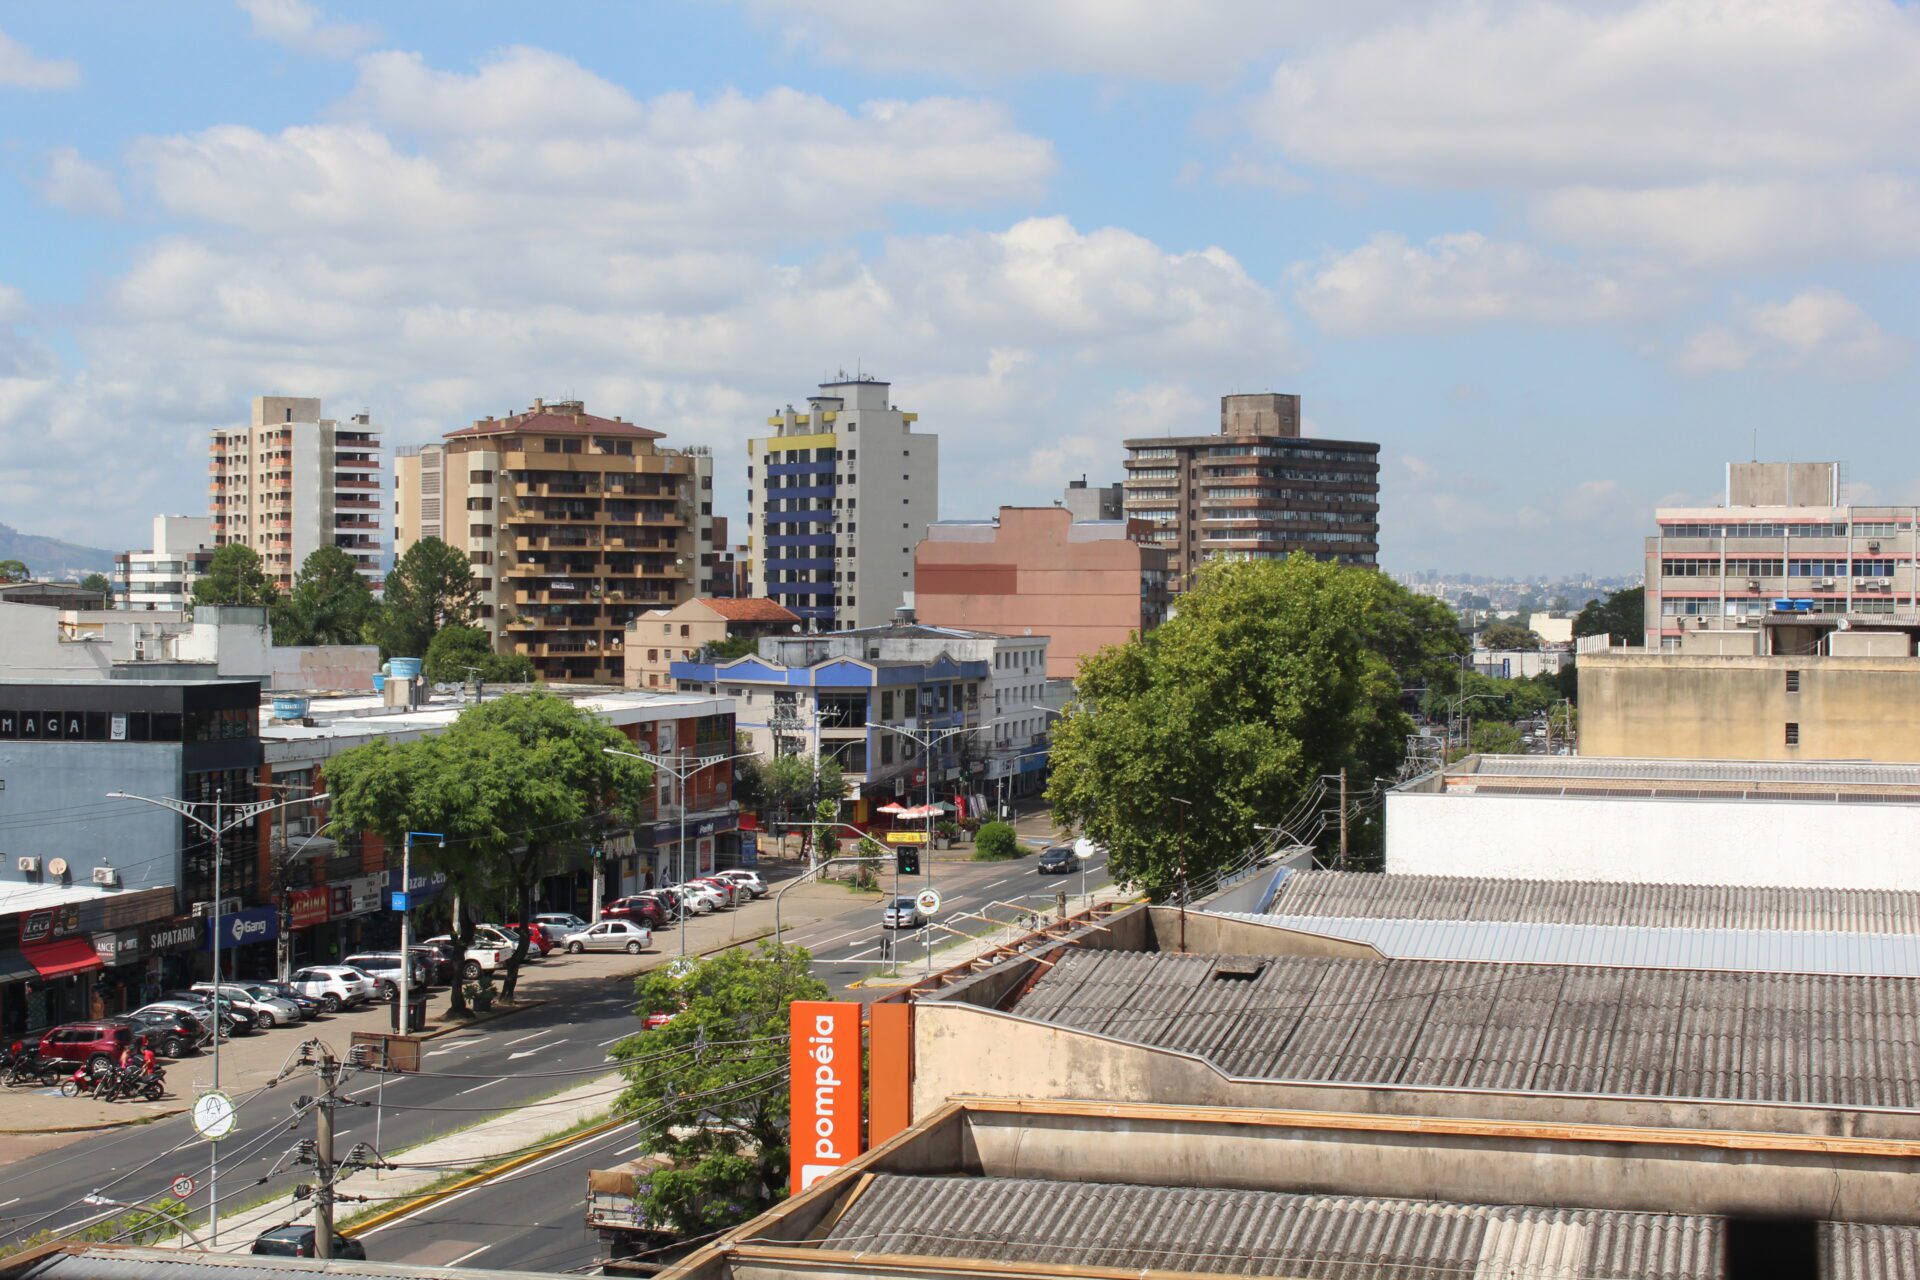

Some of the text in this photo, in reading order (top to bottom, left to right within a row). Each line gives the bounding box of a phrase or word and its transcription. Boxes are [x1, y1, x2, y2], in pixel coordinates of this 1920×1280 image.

[409, 877, 427, 889] azar
[244, 920, 267, 934] Gang
[150, 926, 196, 949] SAPATARIA
[809, 1015, 842, 1159] pompéia
